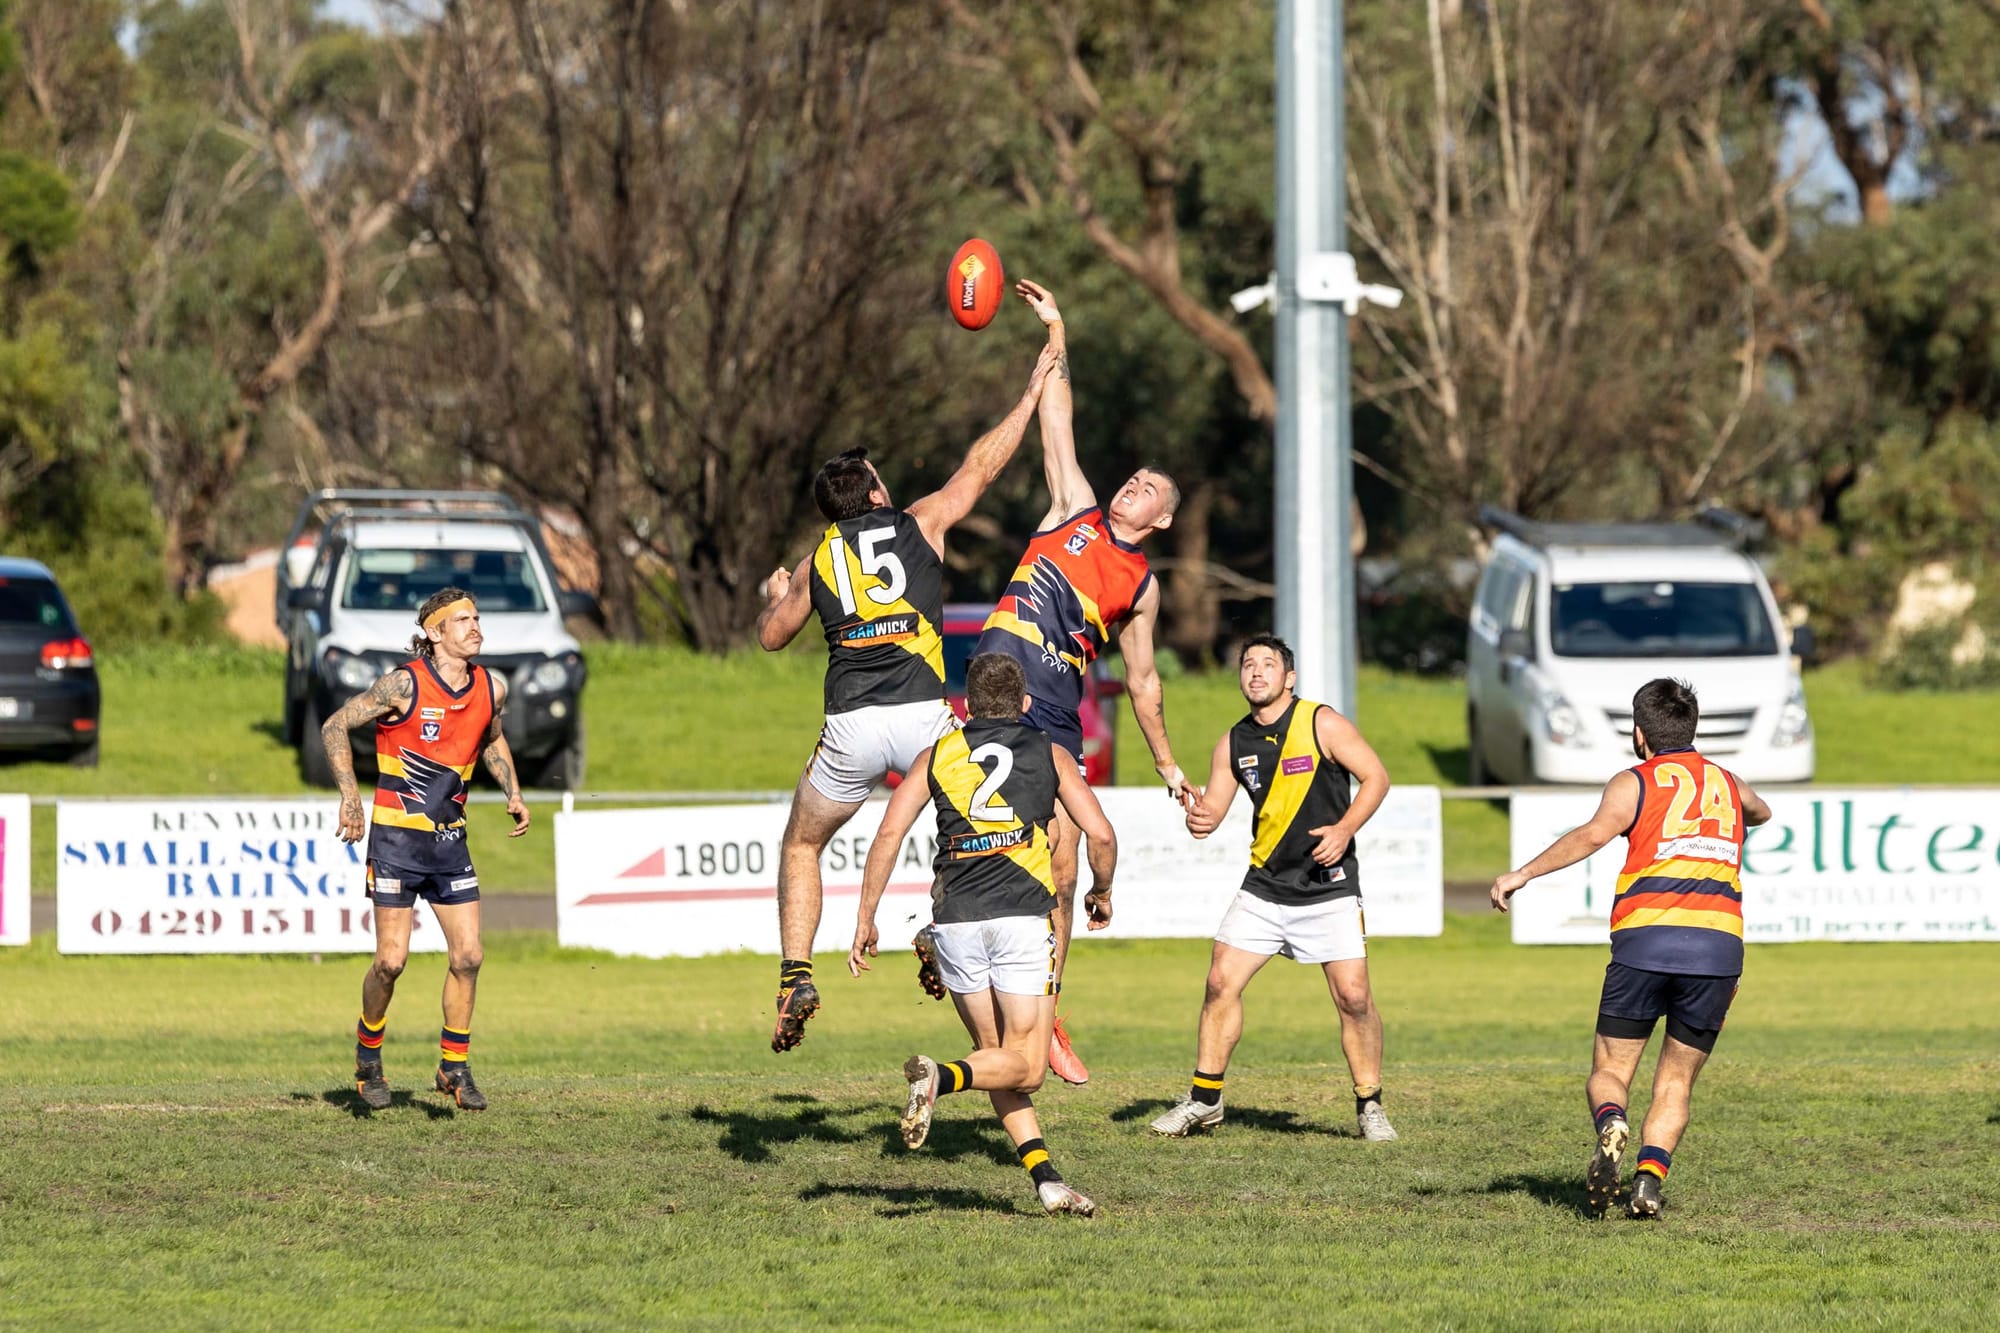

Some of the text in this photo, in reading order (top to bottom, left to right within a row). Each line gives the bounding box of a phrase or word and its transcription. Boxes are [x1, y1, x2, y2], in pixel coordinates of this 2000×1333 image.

[829, 525, 907, 617] 15
[968, 742, 1015, 822] 2
[1654, 762, 1737, 839] 24
[153, 811, 221, 832] KEN
[1741, 799, 2000, 876] ellte
[64, 839, 360, 869] SMALL SQUA
[675, 841, 765, 878] 1800
[167, 873, 346, 897] BALING
[90, 909, 223, 936] 0429
[241, 908, 316, 935] 151
[1747, 916, 1812, 933] ou'll
